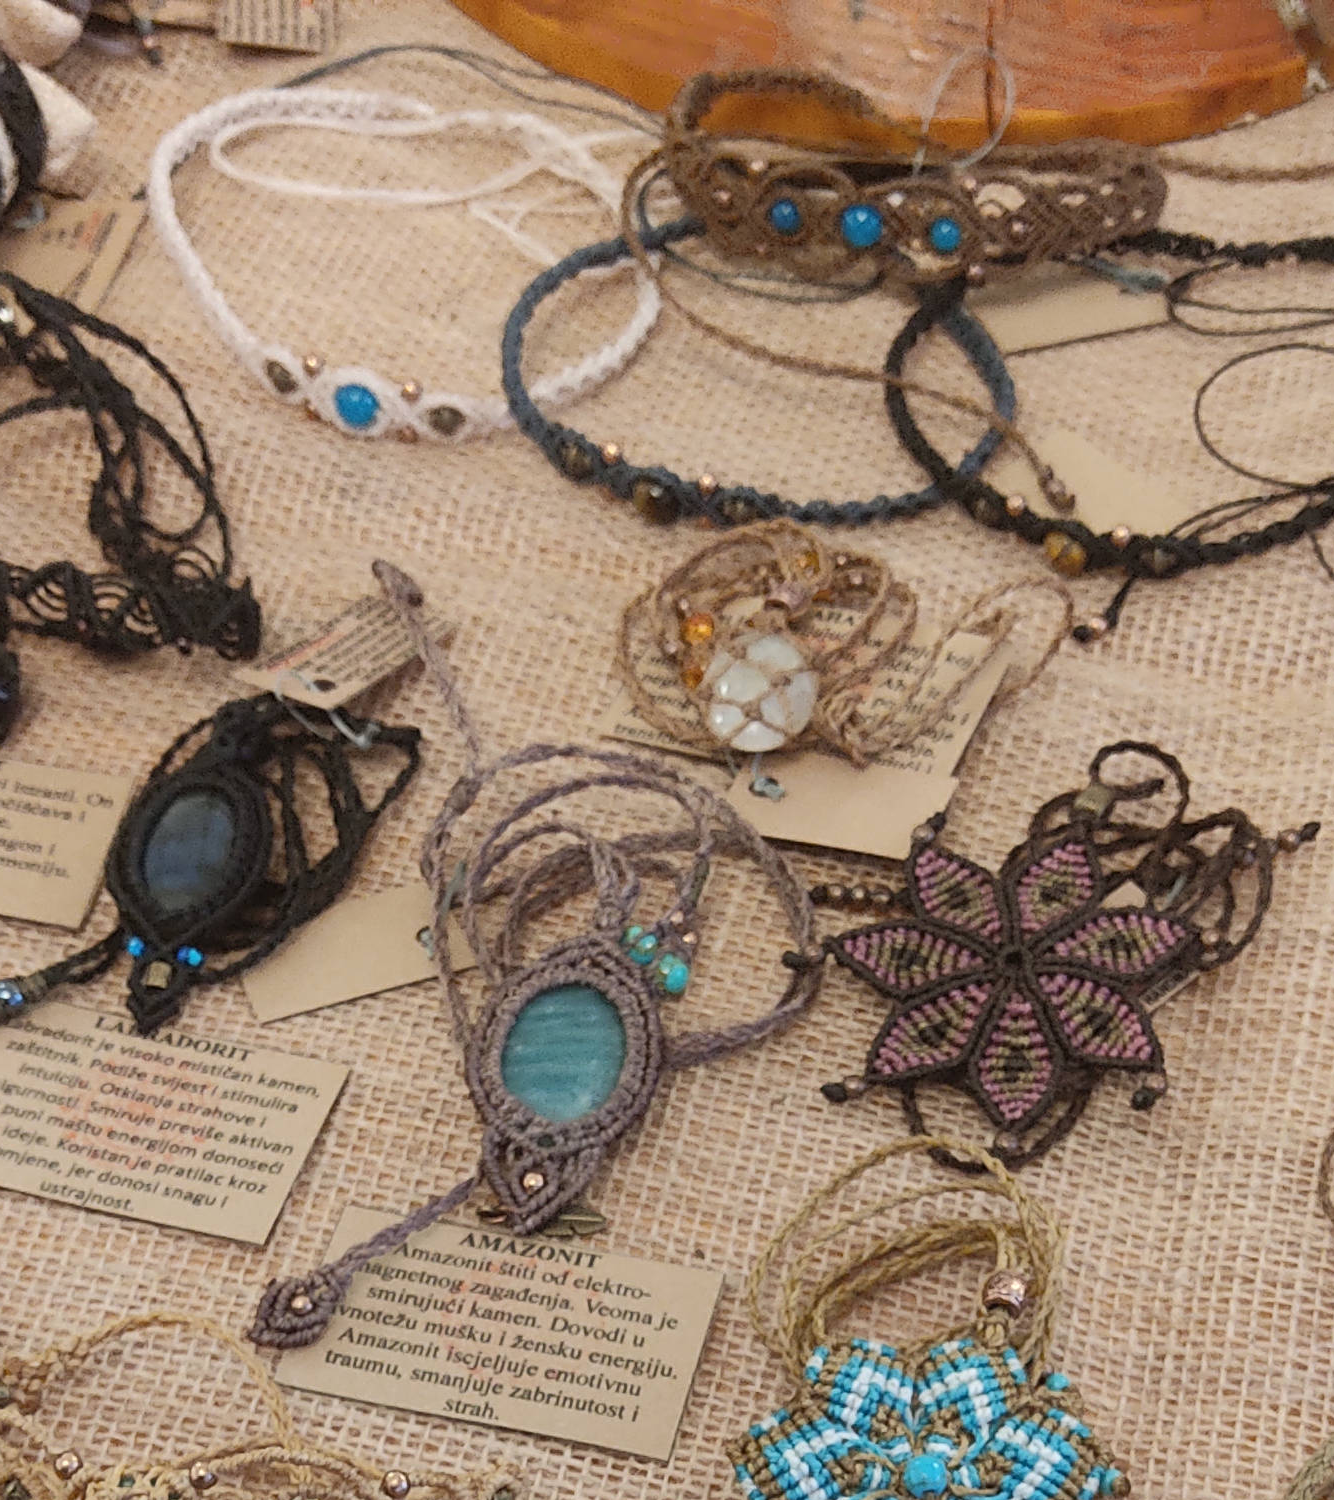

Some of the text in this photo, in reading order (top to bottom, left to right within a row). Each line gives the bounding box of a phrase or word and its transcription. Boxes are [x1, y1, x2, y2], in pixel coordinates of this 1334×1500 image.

[392, 1240, 651, 1299] Amazonit štiti od elektro-
[459, 1232, 601, 1267] AMAZONIT
[366, 1286, 645, 1347] smirujući kamen. Dovodi u
[443, 1399, 498, 1420] strah.
